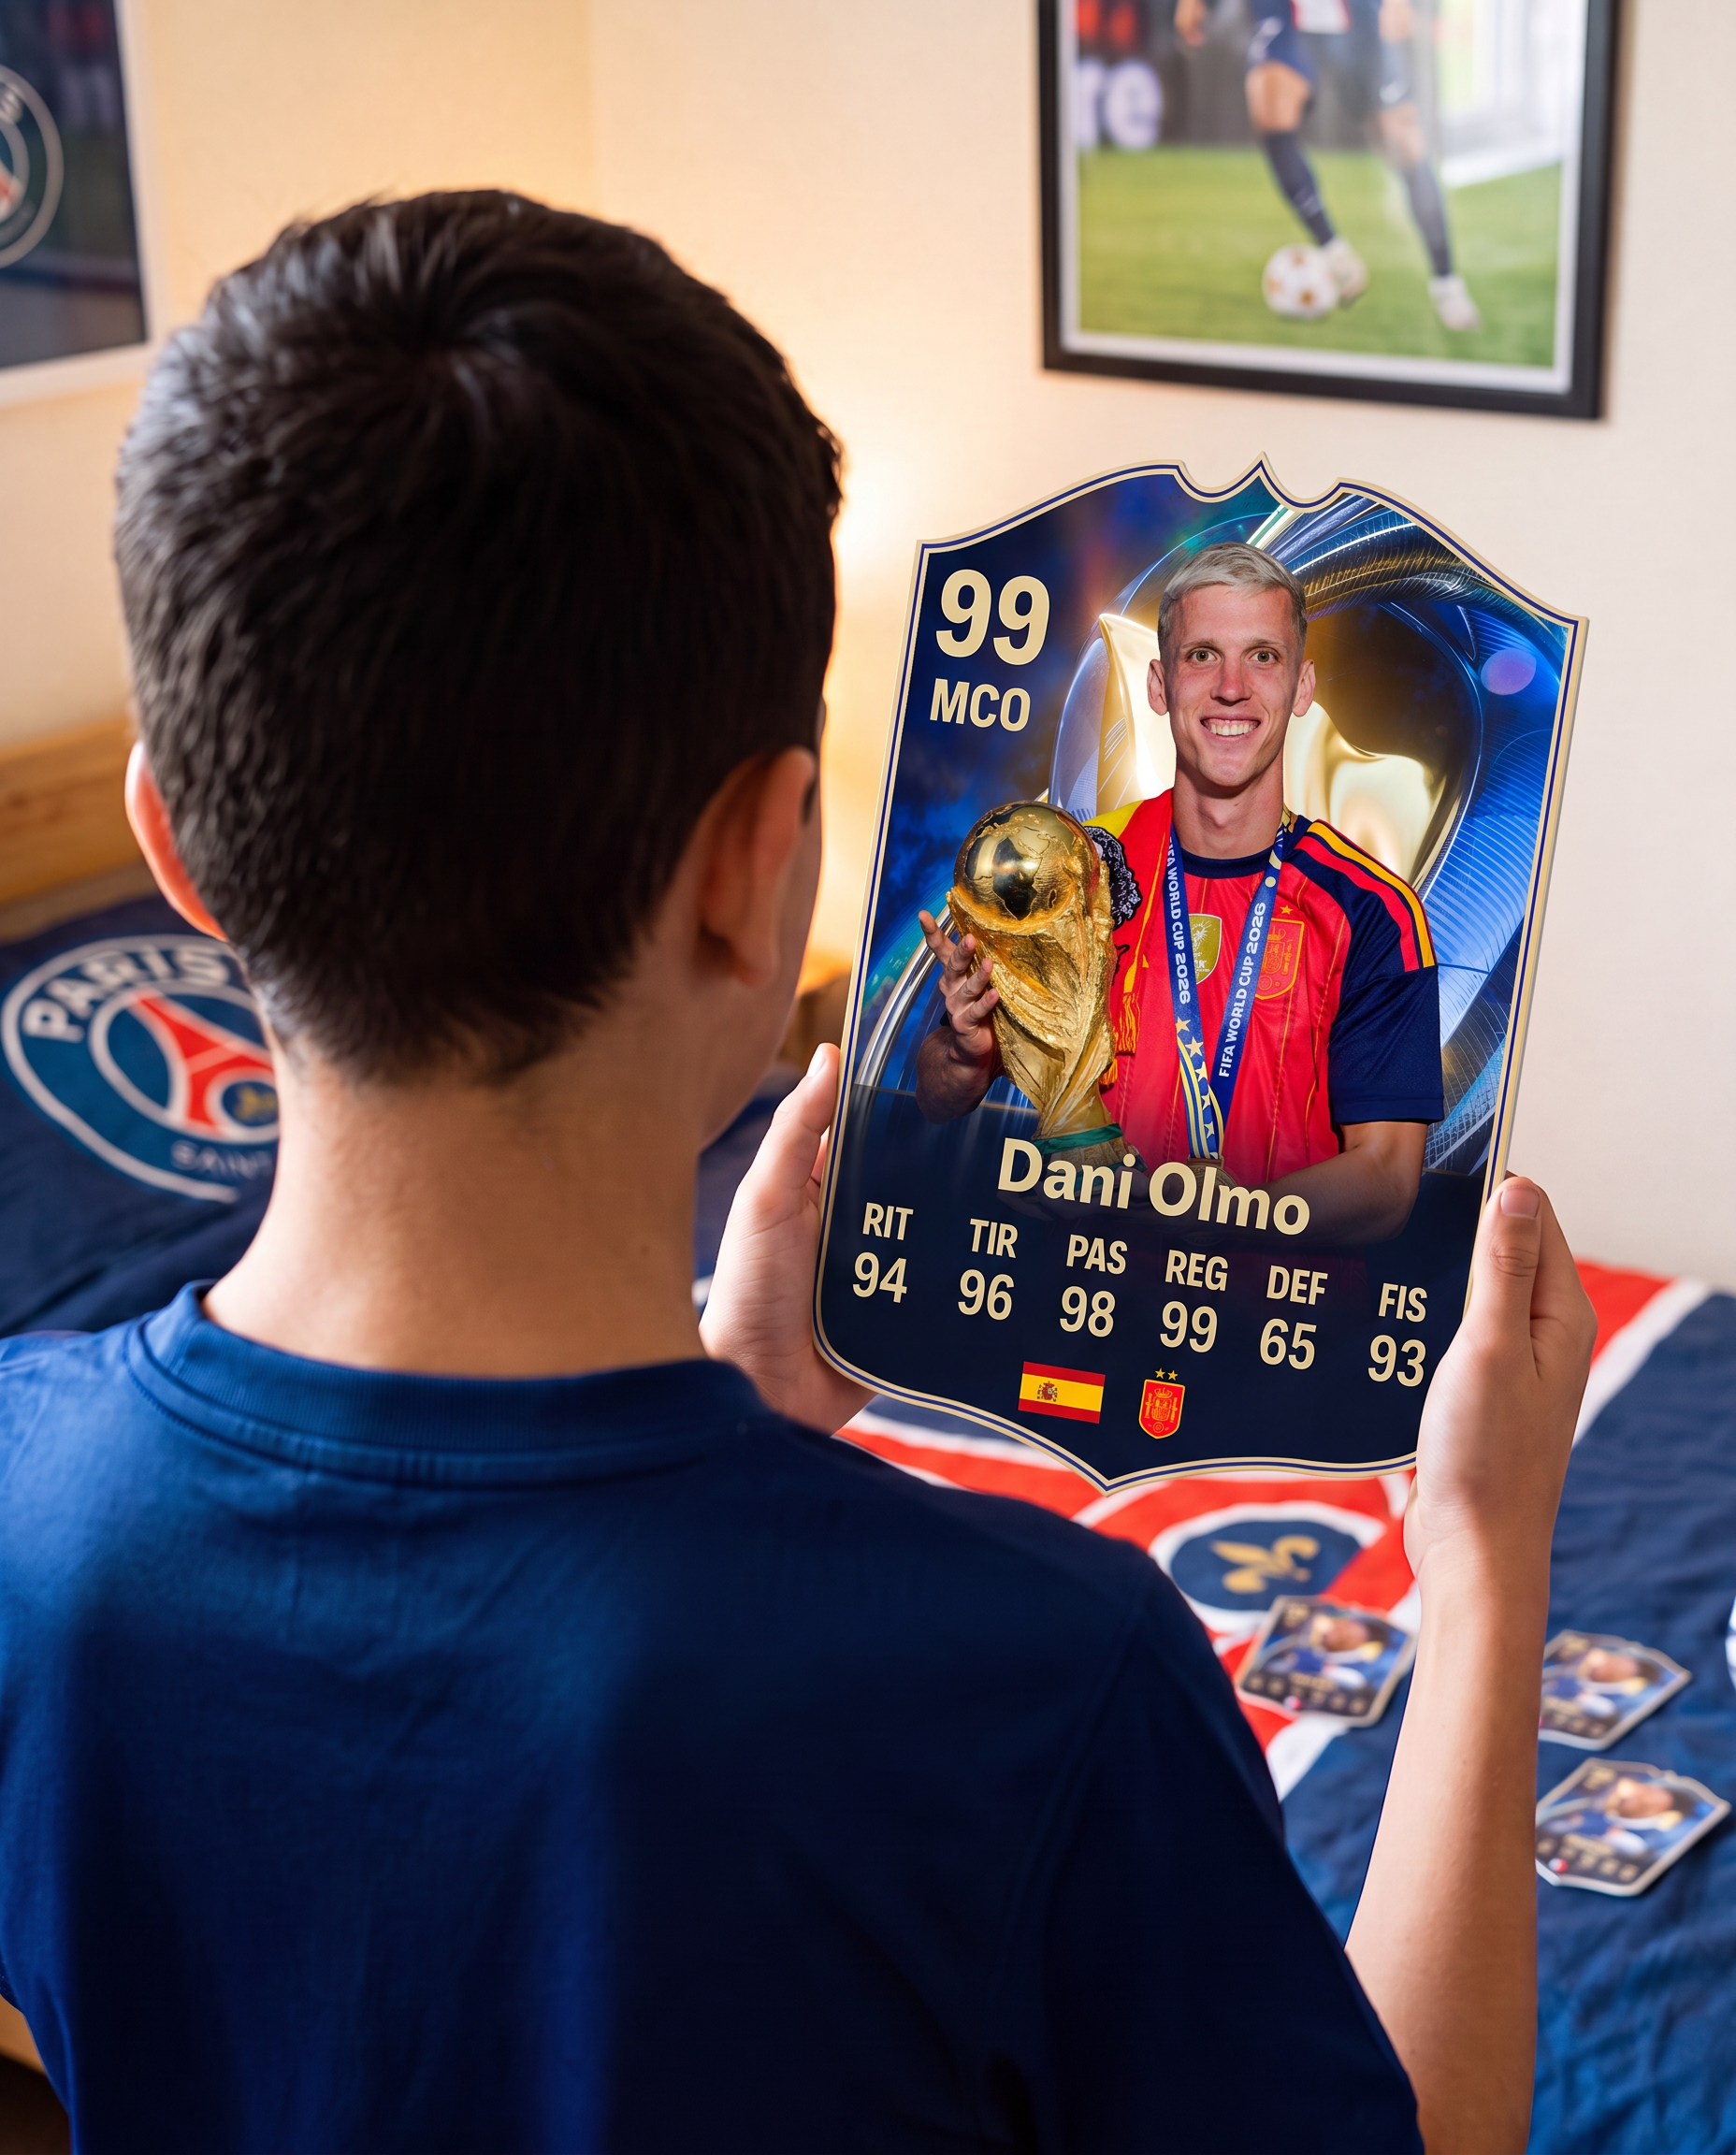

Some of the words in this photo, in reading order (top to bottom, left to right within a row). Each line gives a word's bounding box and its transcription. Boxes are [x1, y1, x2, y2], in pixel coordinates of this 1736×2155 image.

[936, 569, 1049, 666] 99
[930, 678, 1031, 731] MCO
[1167, 866, 1182, 919] WORLD
[1171, 921, 1185, 950] CUP
[1246, 902, 1266, 955] 2026
[22, 944, 229, 1043] PARIS
[1175, 952, 1191, 1005] 2026
[1238, 955, 1254, 987] CUP
[1225, 988, 1248, 1043] WORLD
[1219, 1045, 1236, 1078] FIFA
[997, 1137, 1136, 1209] Dani
[1149, 1162, 1310, 1236] Olmo
[862, 1202, 914, 1240] RIT
[969, 1218, 1019, 1258] TIR
[1066, 1234, 1128, 1275] PAS
[1165, 1250, 1229, 1292] REG
[1266, 1265, 1328, 1306] DEF
[1378, 1282, 1428, 1323] FIS
[852, 1251, 908, 1304] 94
[958, 1269, 1015, 1321] 96
[1060, 1286, 1116, 1338] 98
[1160, 1301, 1218, 1353] 99
[1260, 1318, 1317, 1370] 65
[1367, 1335, 1426, 1387] 93
